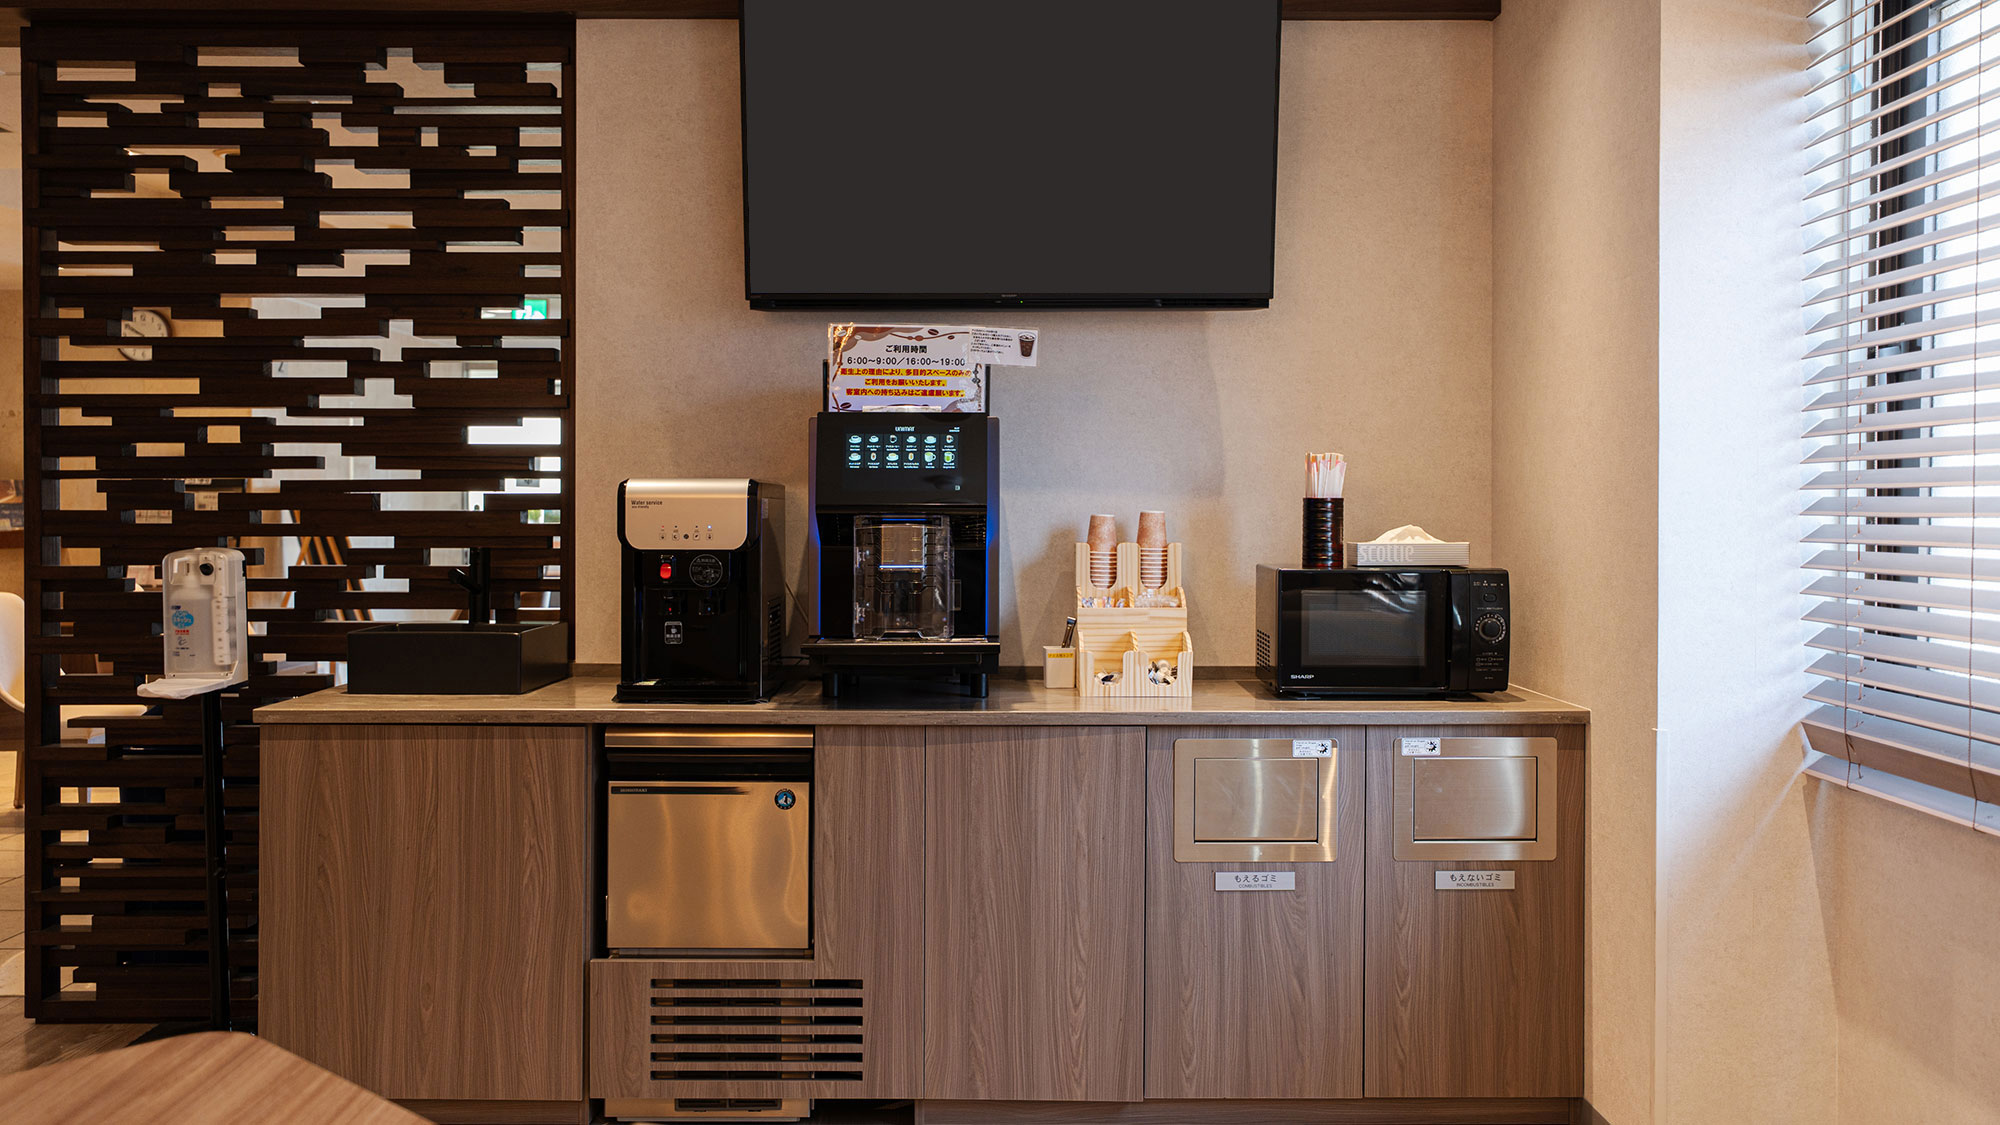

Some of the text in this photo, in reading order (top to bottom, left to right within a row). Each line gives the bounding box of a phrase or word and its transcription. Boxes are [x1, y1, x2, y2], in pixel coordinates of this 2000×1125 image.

[885, 345, 928, 354] ご利用時間
[864, 379, 946, 387] ご利用をお願いいたします。
[1359, 545, 1414, 562] scottie
[1234, 873, 1277, 883] もえるゴミ
[1450, 872, 1502, 882] もえないゴミ
